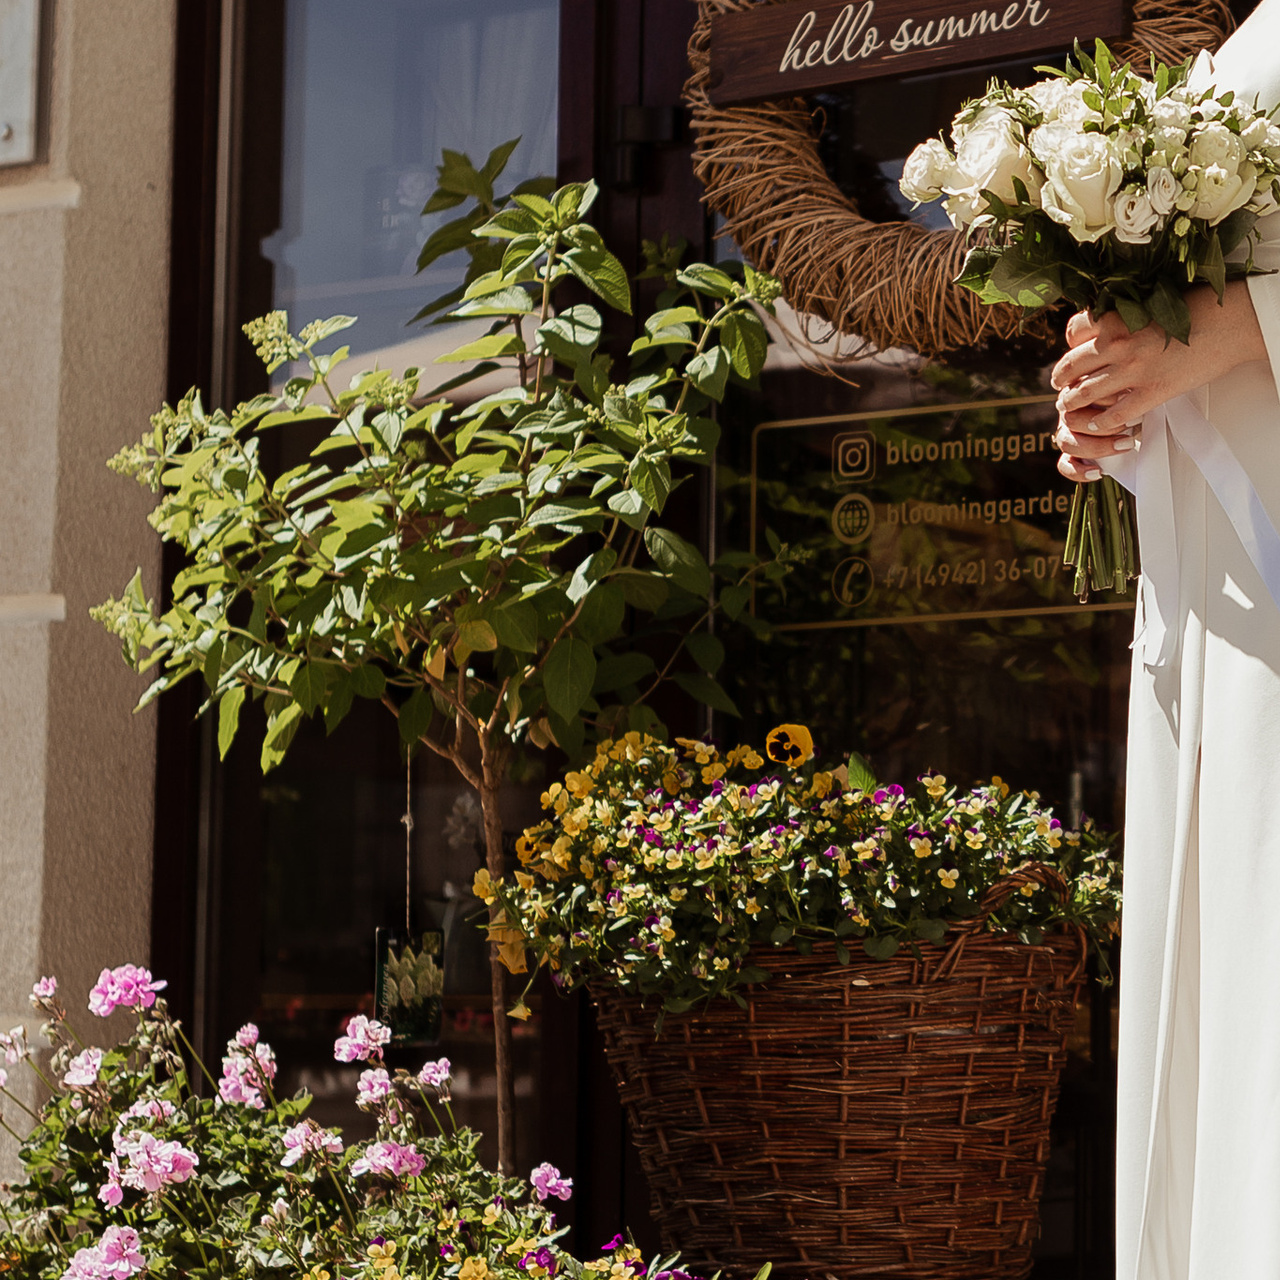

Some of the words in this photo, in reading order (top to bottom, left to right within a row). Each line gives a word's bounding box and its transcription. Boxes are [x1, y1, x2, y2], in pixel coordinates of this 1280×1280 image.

[778, 0, 885, 73] hello
[886, 490, 1075, 526] bloominggarde
[994, 554, 1072, 583] 36-07-
